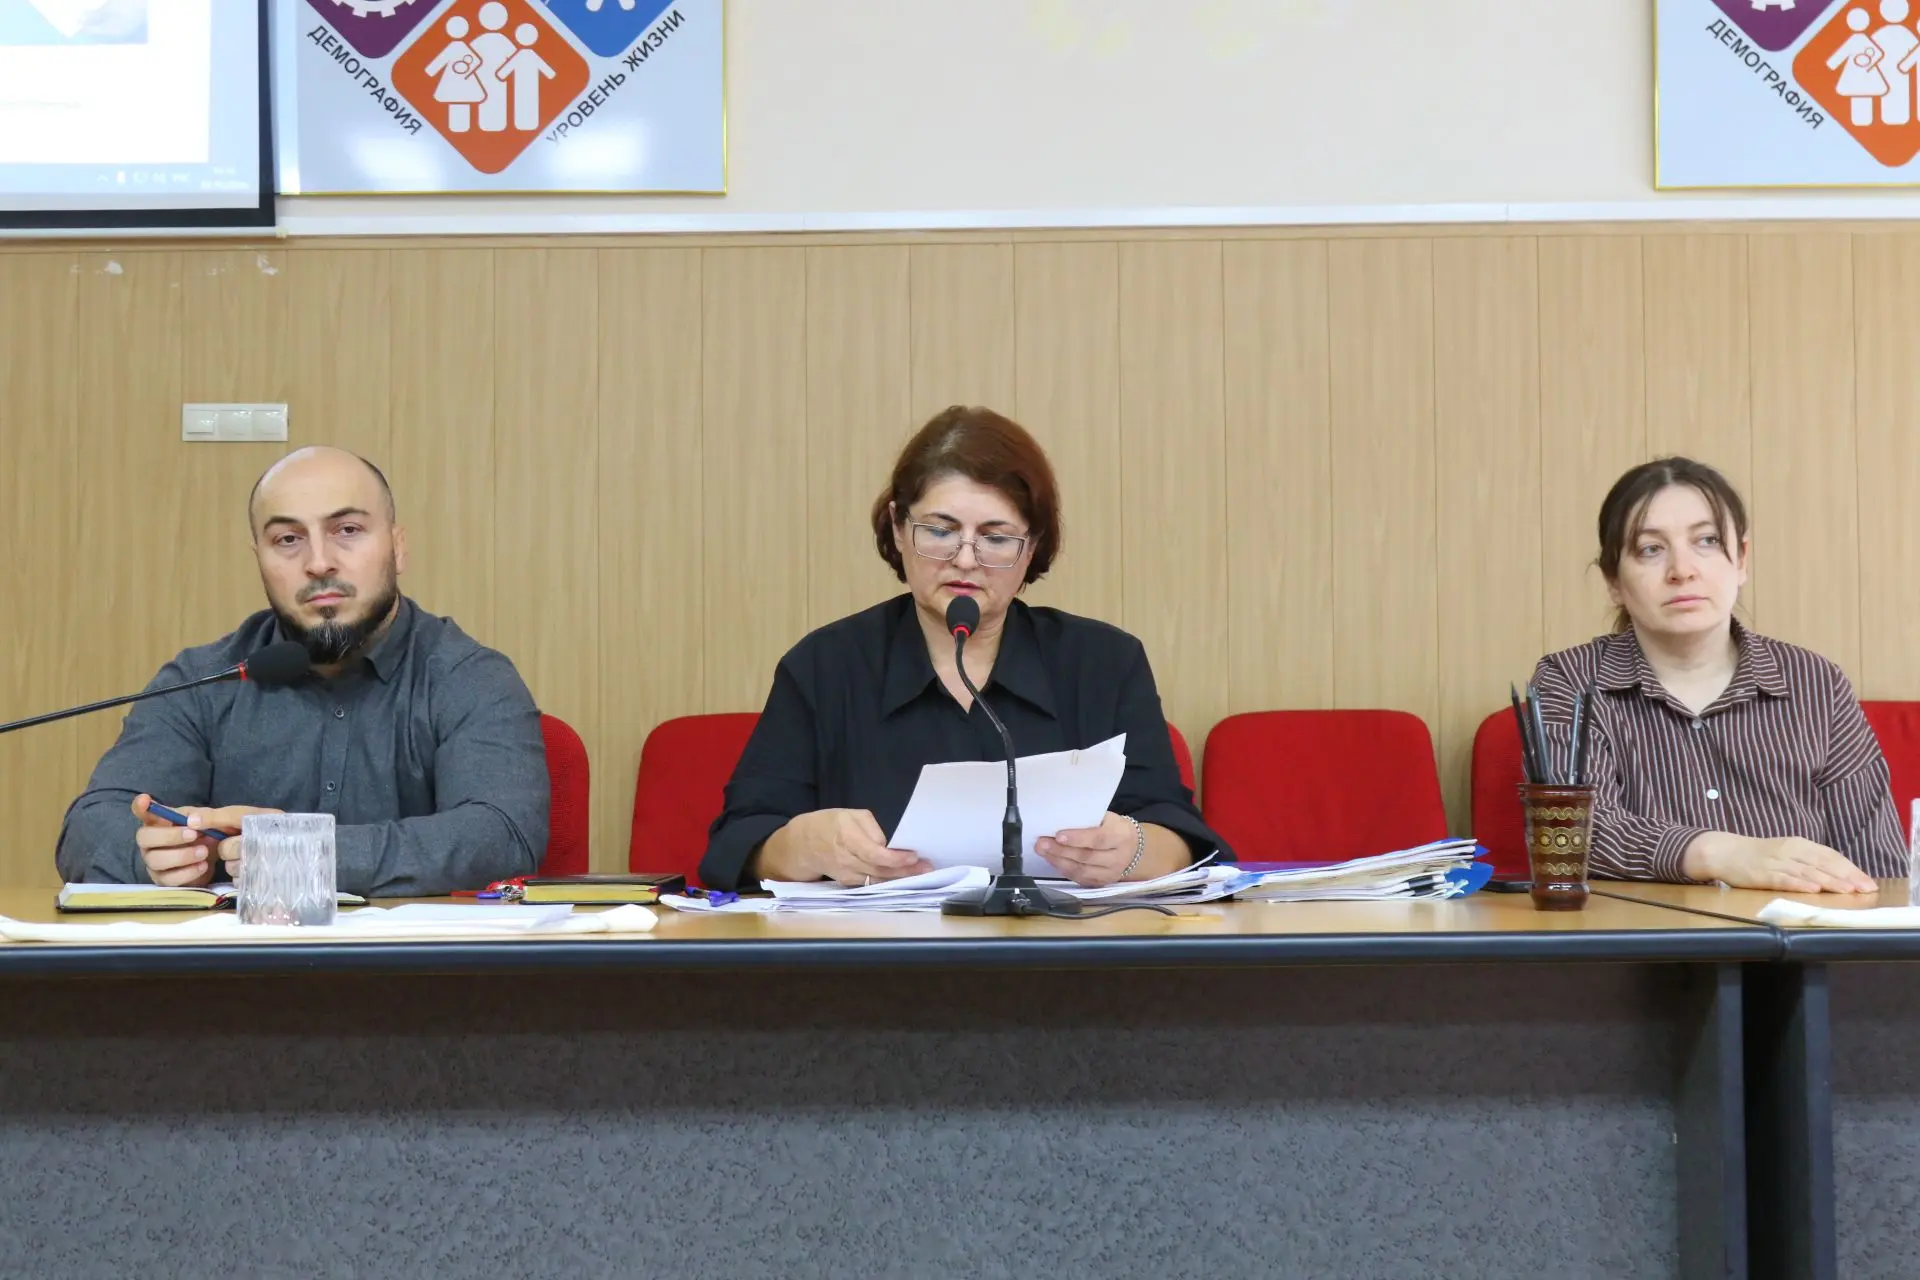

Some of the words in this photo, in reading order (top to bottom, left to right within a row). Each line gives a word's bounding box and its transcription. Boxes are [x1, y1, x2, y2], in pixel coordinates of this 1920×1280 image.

[306, 25, 423, 136] ДЕМОГРАФИЯ
[545, 72, 626, 145] УРОВЕНЬ
[622, 9, 686, 72] ЖИЗНИ
[1706, 18, 1825, 130] ДЕМОГРАФИЯ
